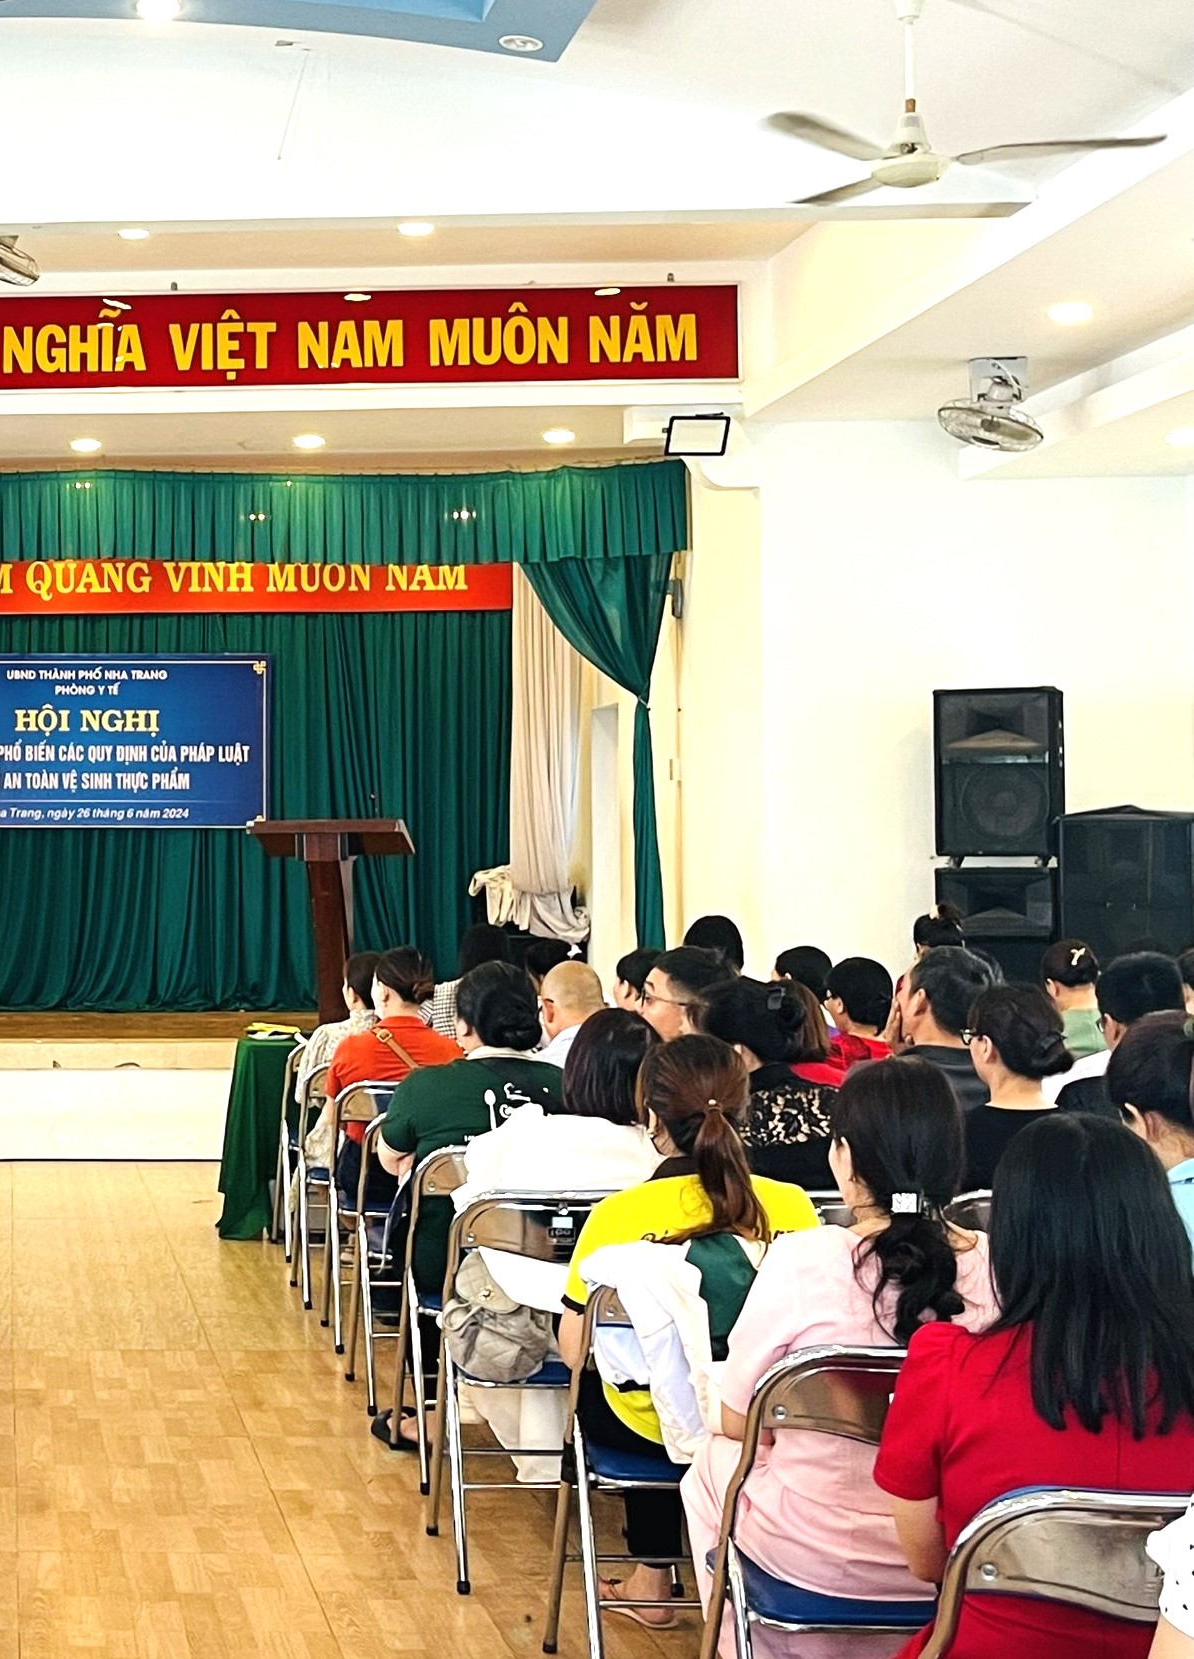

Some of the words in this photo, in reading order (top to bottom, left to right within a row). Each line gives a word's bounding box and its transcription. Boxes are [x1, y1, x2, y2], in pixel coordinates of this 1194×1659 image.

[3, 308, 146, 373] NGHĨA
[169, 309, 276, 380] VIỆT
[298, 319, 403, 369] NAM
[430, 303, 568, 367] MUÔN
[590, 303, 697, 364] NĂM
[162, 561, 255, 593] VINH
[6, 669, 37, 680] UBND
[38, 667, 76, 680] THÀNH
[77, 666, 103, 680] PHỐ
[104, 669, 129, 680] NHA
[131, 669, 168, 680] TRANG
[54, 682, 96, 696] PHÒNG
[97, 685, 106, 696] Y
[107, 681, 122, 696] TẾ
[14, 703, 71, 737] HỘI
[79, 709, 160, 738] NGHỊ
[24, 739, 56, 762] BIẾN
[58, 741, 85, 762] CÁC
[87, 745, 113, 764] QUY
[116, 745, 148, 766] ĐỊNH
[150, 739, 178, 762] CỦA
[180, 741, 215, 762] PHÁP
[218, 742, 250, 766] LUẬT
[3, 772, 22, 790] AN
[24, 769, 59, 790] TOÀN
[61, 768, 78, 793] VỆ
[81, 772, 113, 790] SINH
[115, 771, 149, 794] THỰC
[151, 766, 190, 790] PHẨM
[9, 807, 46, 821] Trang,
[46, 807, 76, 821] ngày
[76, 807, 91, 819] 26
[92, 807, 125, 821] tháng
[126, 808, 135, 819] 6
[161, 807, 189, 819] 2024
